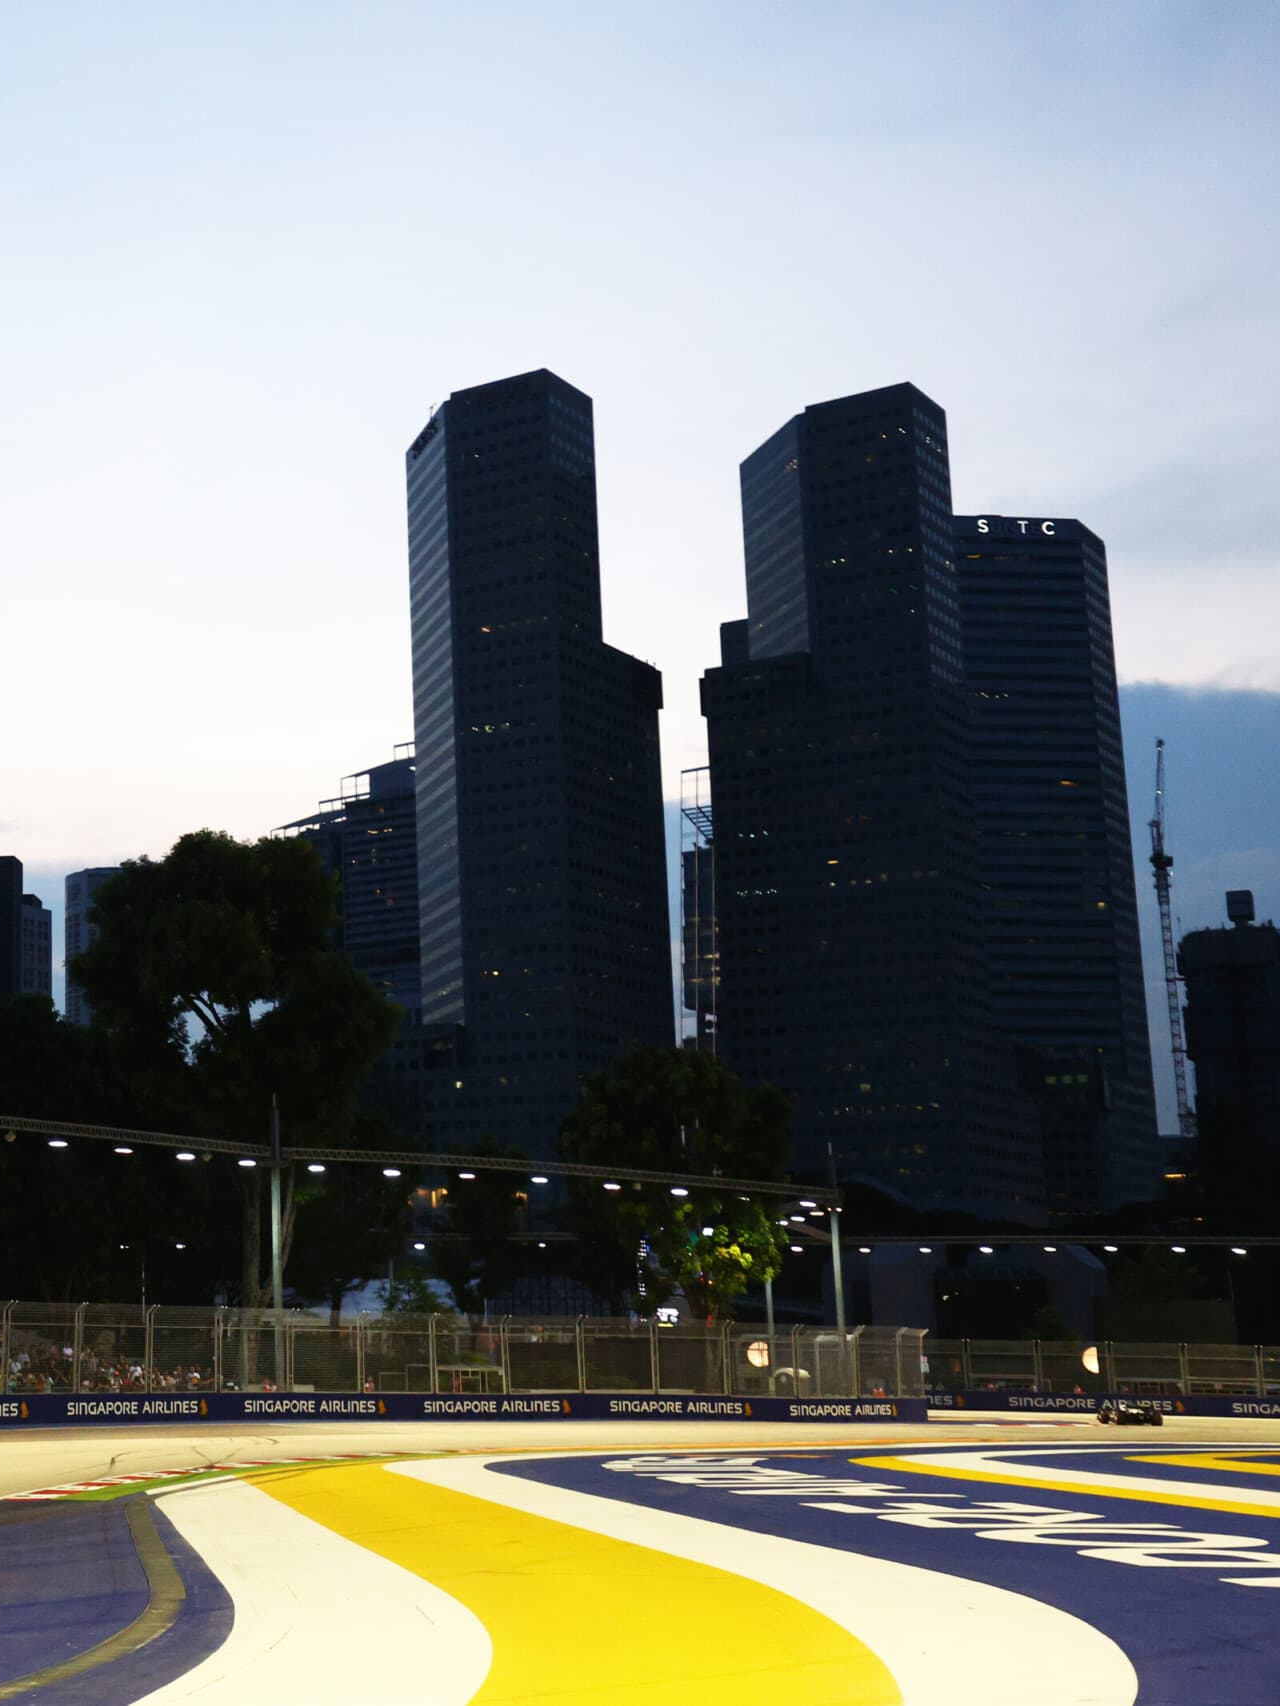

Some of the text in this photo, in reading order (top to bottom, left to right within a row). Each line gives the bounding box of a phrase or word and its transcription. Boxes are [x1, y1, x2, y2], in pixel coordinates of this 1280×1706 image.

[67, 1400, 199, 1416] SINGAPORE AIRLINES
[244, 1399, 376, 1413] SINGAPORE AIRLINES
[424, 1400, 560, 1413] SINGAPORE AIRLINES
[609, 1400, 743, 1414] SINGAPORE AIRLINES
[1008, 1396, 1096, 1409] SINGAPORE
[790, 1404, 892, 1417] SINGAPORE AIRLINES
